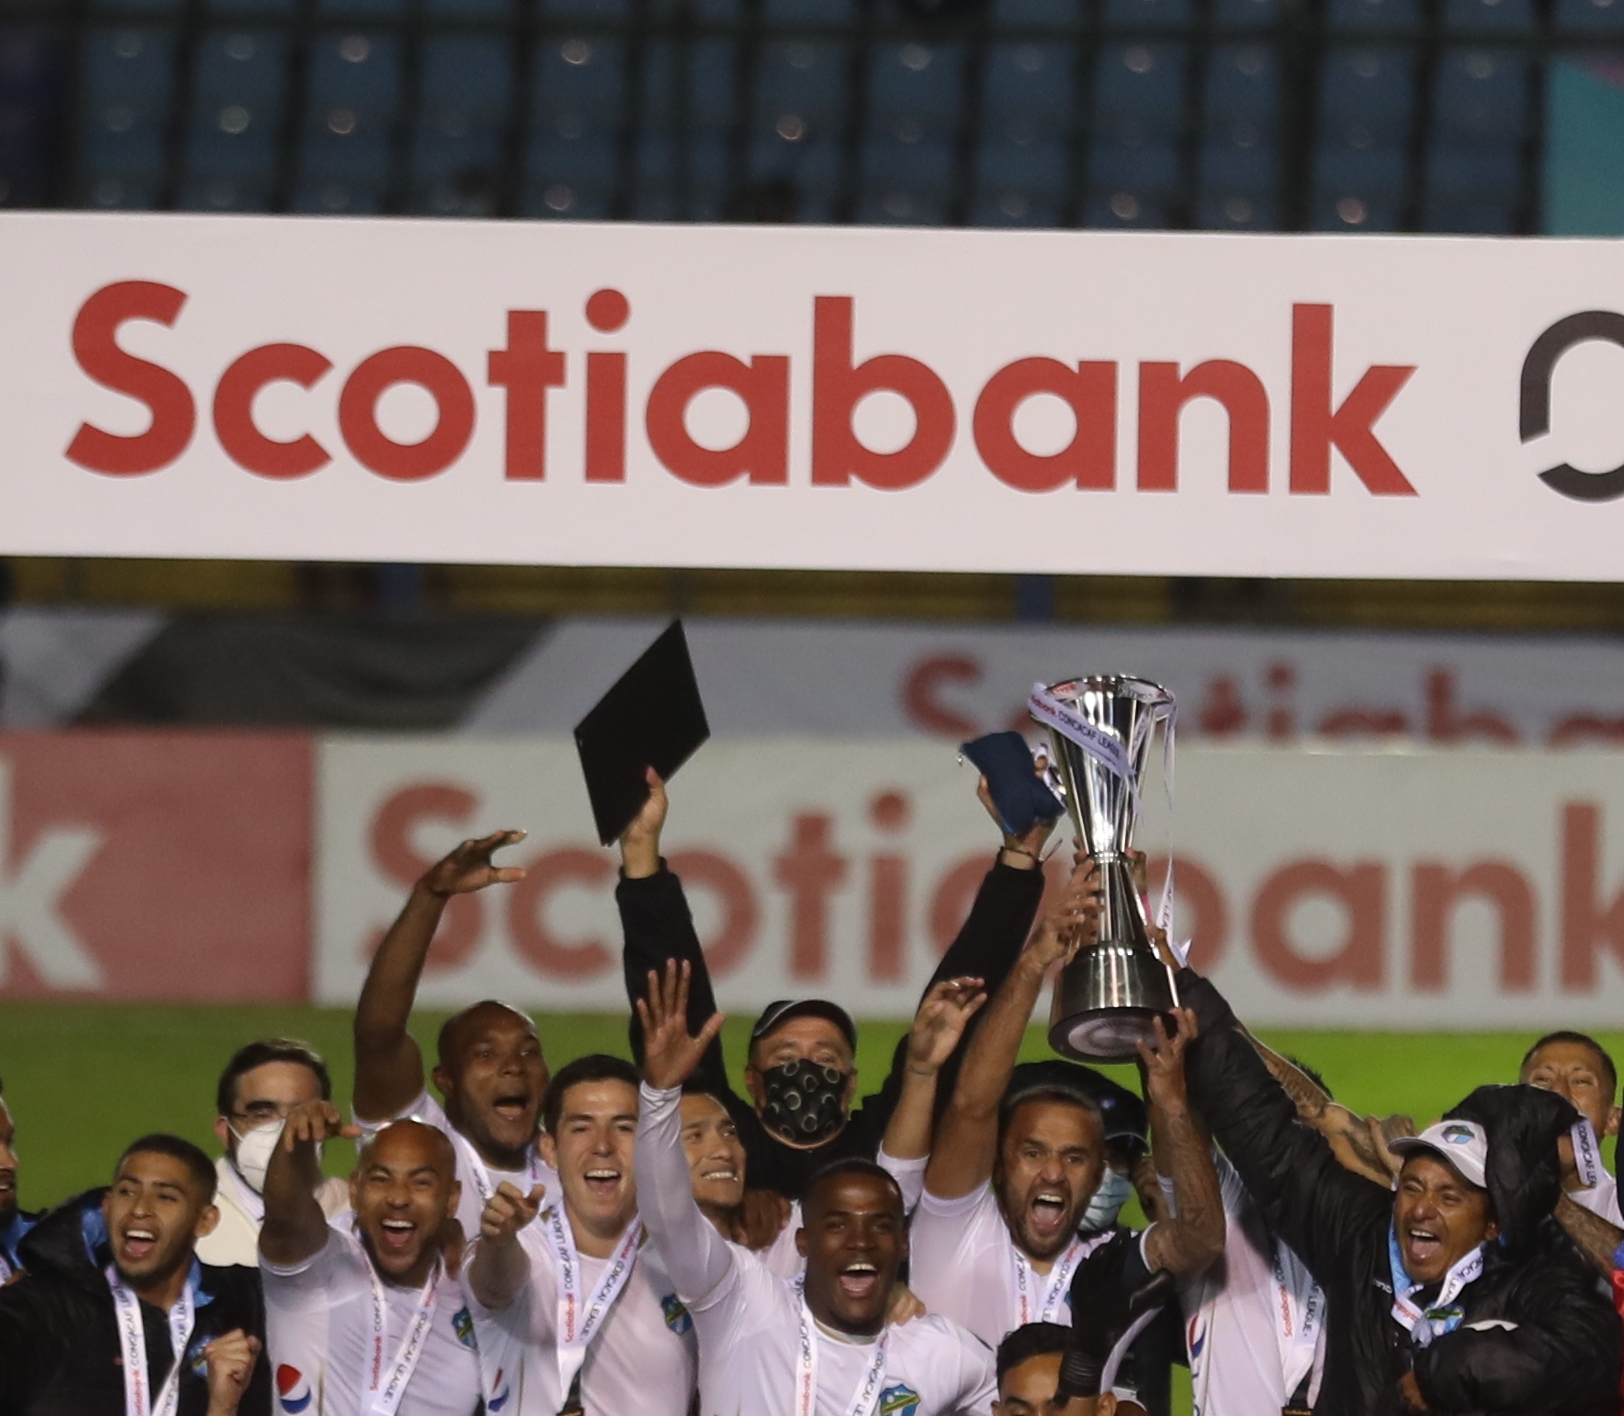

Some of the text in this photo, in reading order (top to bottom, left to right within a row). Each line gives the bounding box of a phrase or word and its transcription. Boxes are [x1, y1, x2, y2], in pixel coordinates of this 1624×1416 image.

[64, 279, 1419, 498] Scotiabank
[1301, 1295, 1318, 1338] LEAGUE
[861, 1351, 886, 1405] CONCACAF
